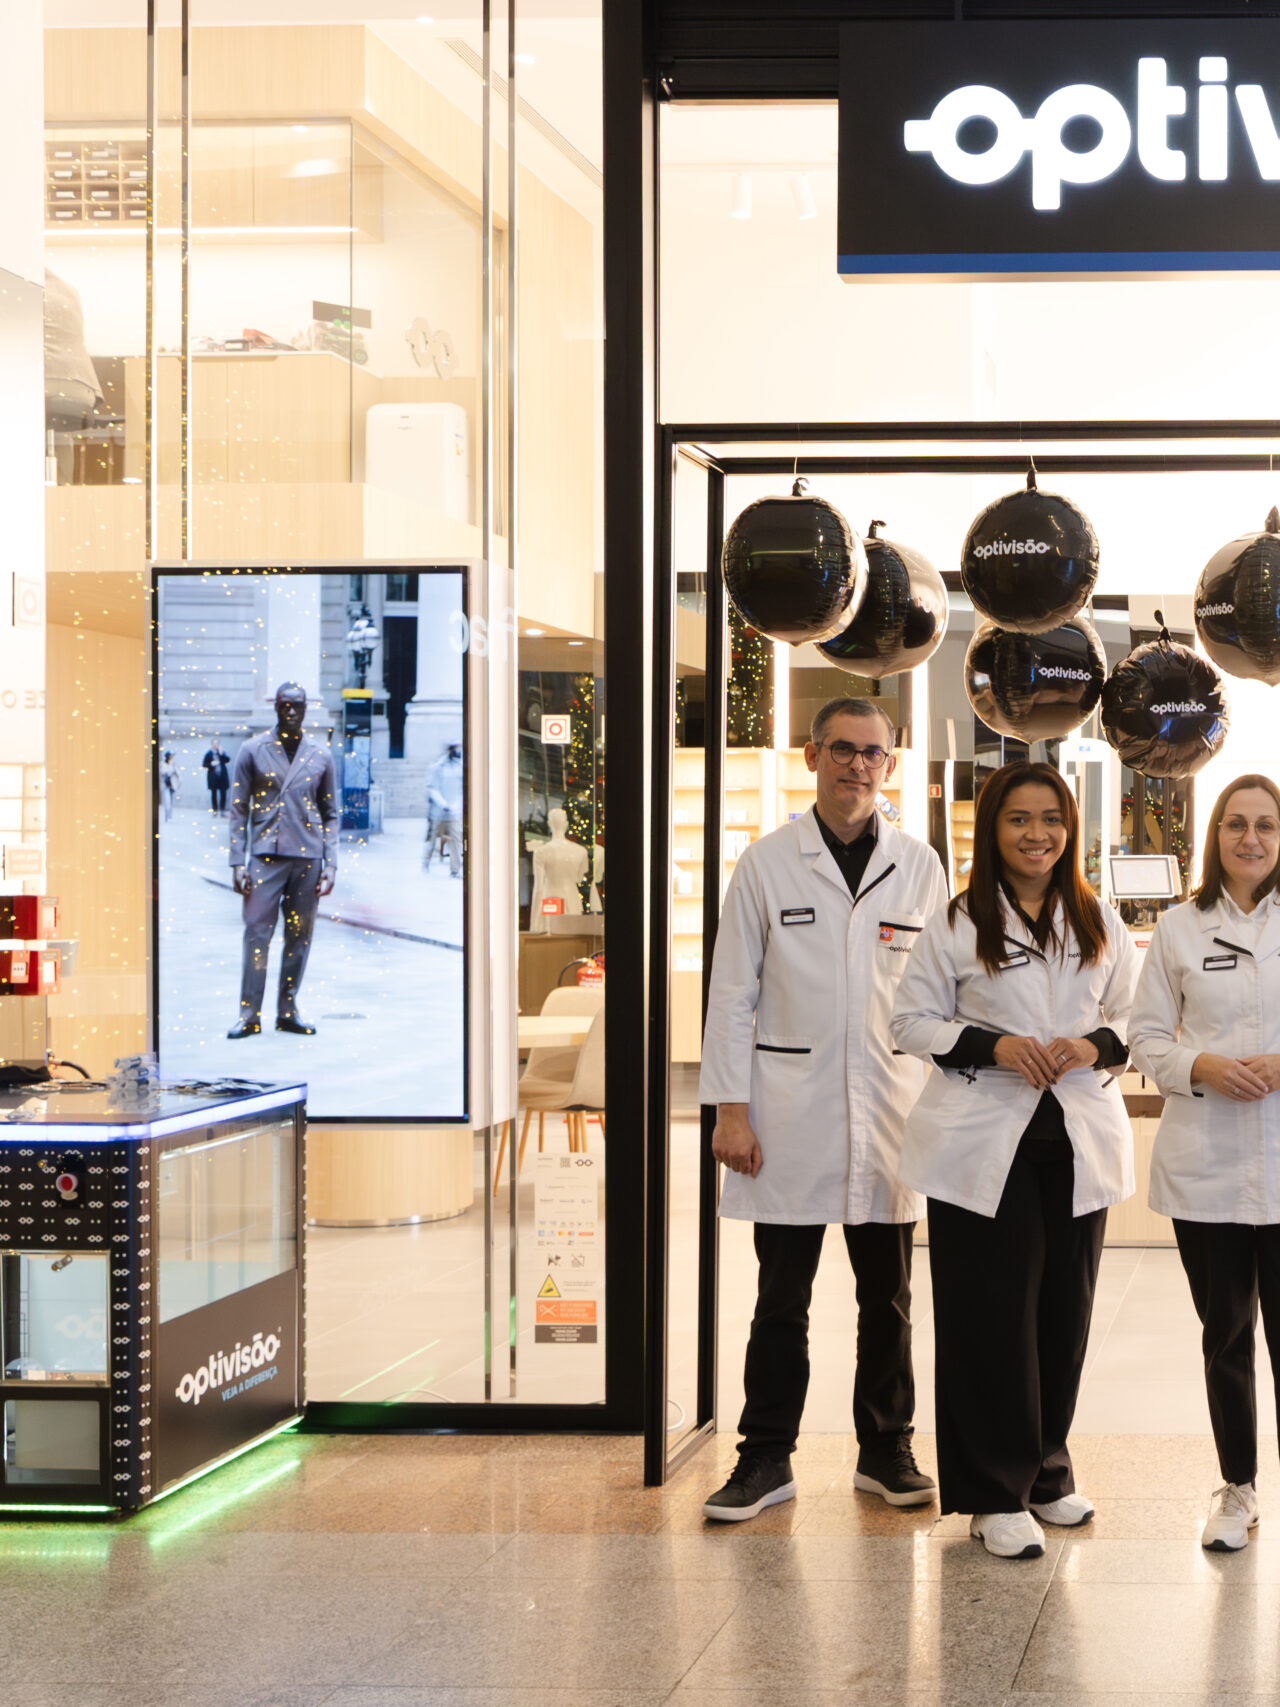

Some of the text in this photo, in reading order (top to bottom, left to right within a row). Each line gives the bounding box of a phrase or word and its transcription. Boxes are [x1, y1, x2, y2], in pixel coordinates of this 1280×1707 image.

[973, 538, 1051, 560] optivisão
[1196, 602, 1236, 619] optivisão
[1038, 666, 1093, 681] optivisão
[1150, 700, 1207, 715] optivisão
[174, 1331, 281, 1406] optivisão
[221, 1365, 278, 1402] VEJA A DIFERENÇA
